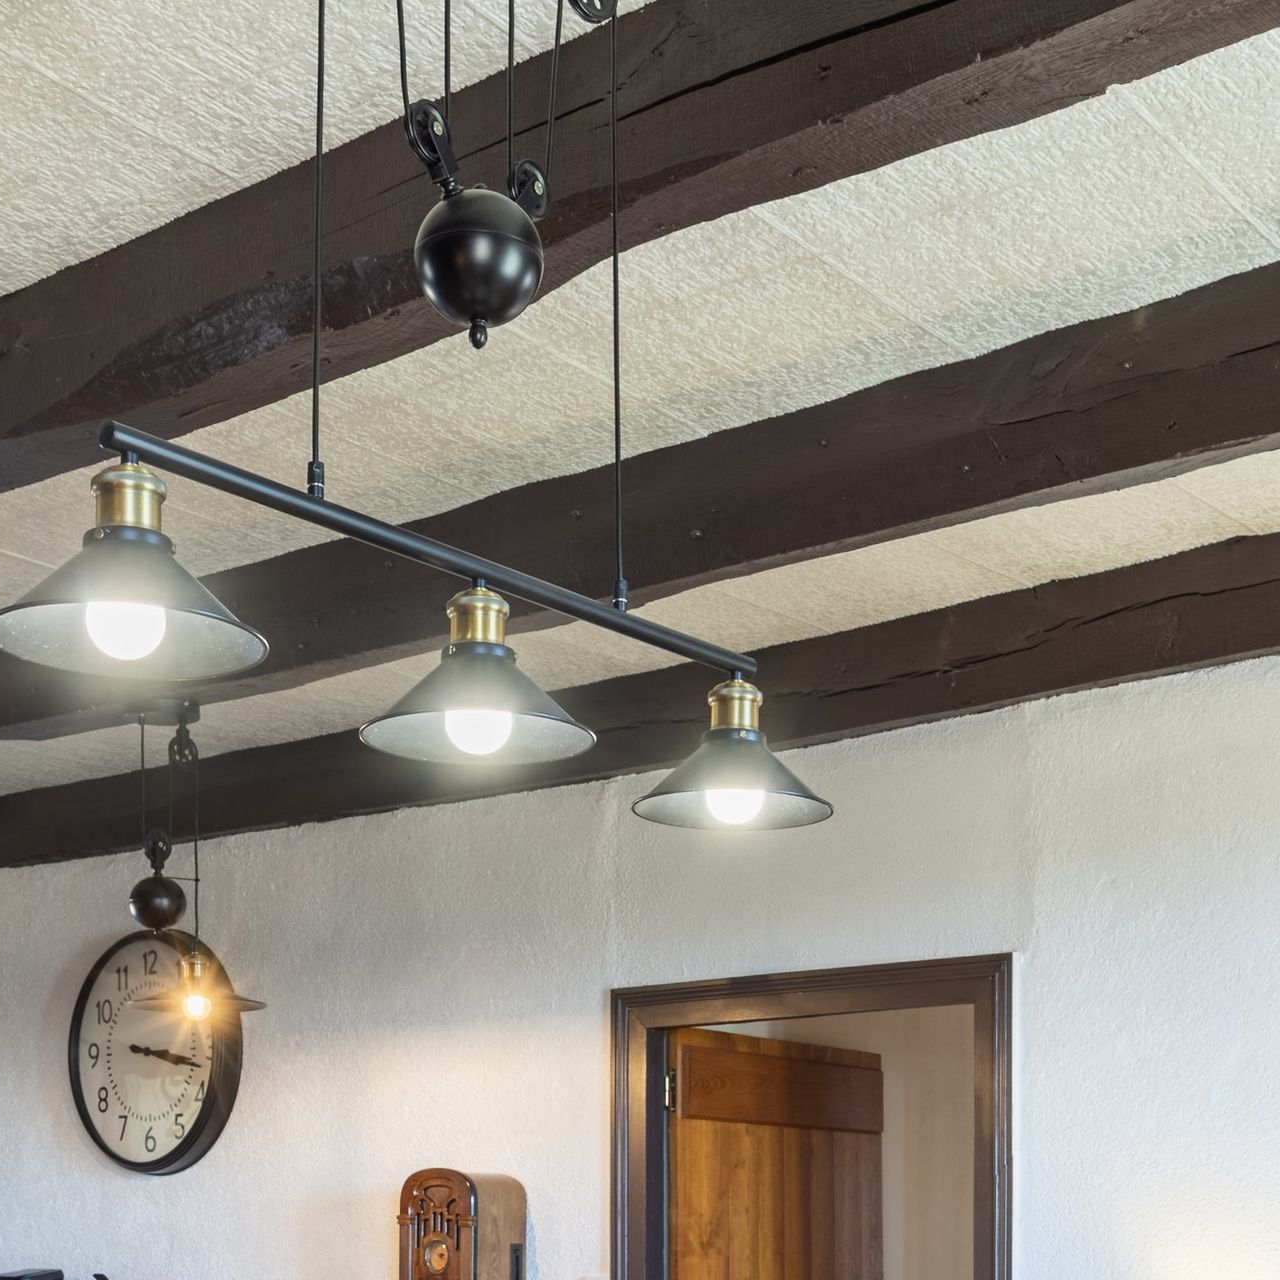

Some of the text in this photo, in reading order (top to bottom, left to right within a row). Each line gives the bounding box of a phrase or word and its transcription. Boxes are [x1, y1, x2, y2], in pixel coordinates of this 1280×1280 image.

[142, 950, 159, 976] 12
[115, 965, 129, 992] 11
[96, 999, 113, 1025] 10
[88, 1042, 100, 1069] 9
[98, 1086, 109, 1113] 8
[194, 1080, 206, 1103] 4
[118, 1115, 129, 1141] 7
[144, 1126, 157, 1153] 6
[174, 1113, 186, 1140] 5
